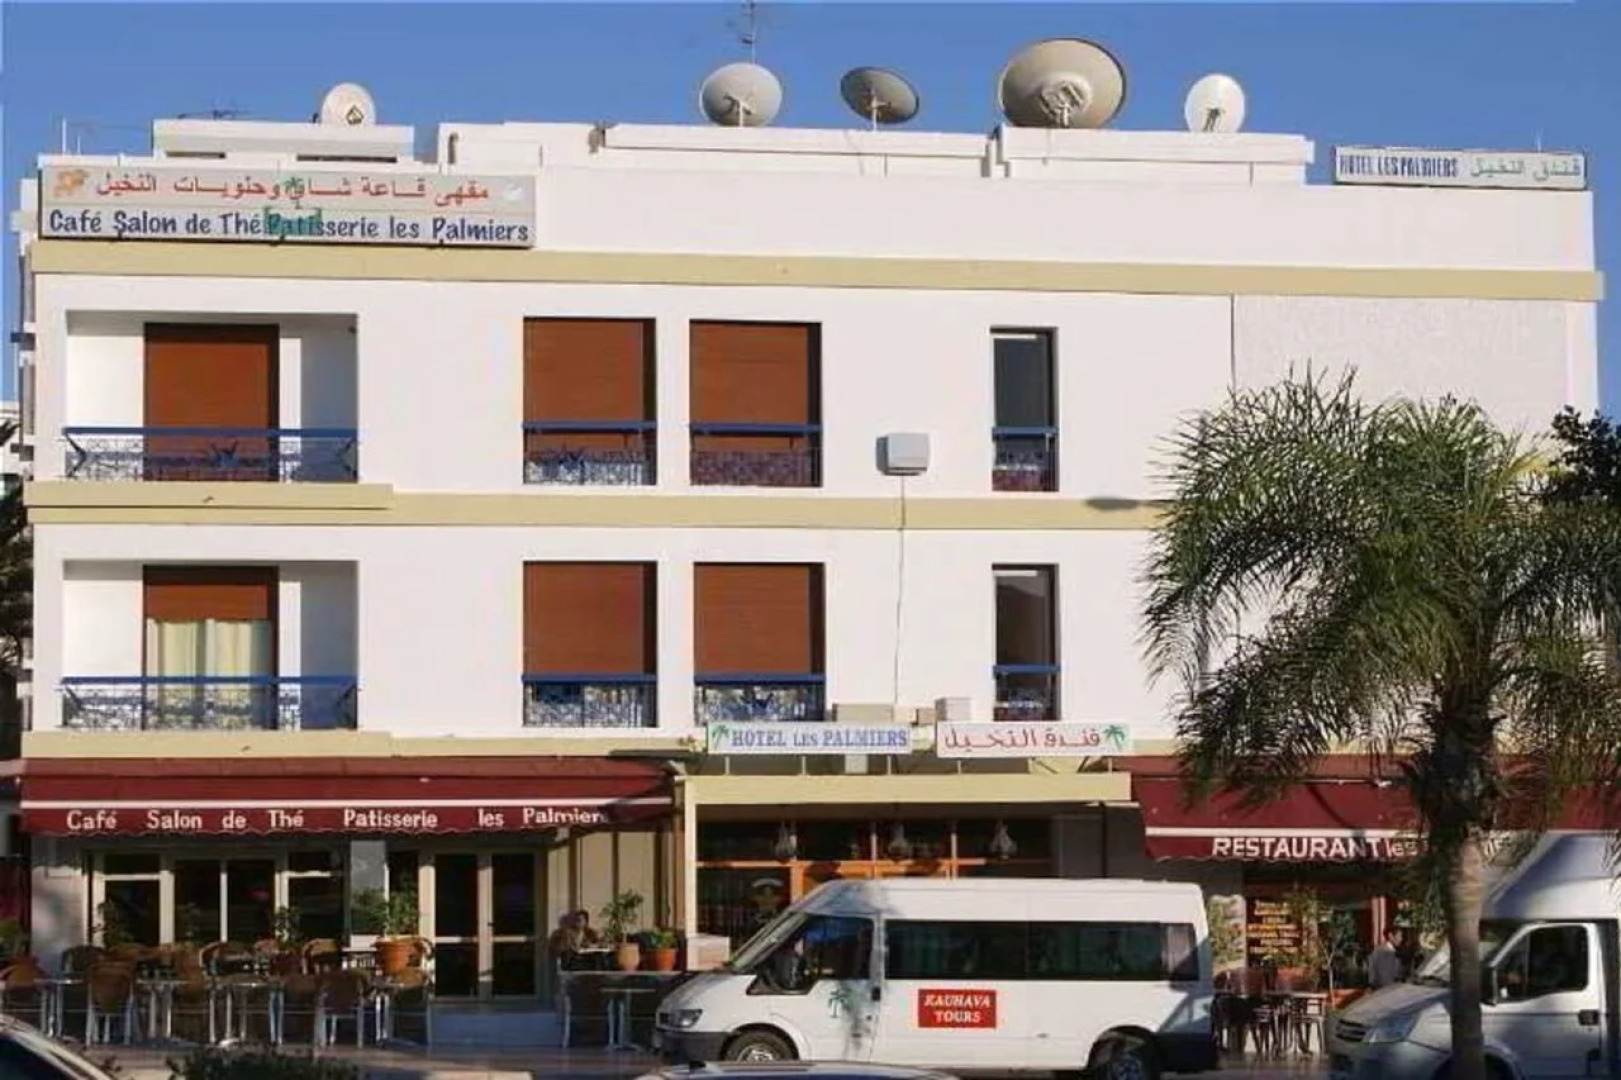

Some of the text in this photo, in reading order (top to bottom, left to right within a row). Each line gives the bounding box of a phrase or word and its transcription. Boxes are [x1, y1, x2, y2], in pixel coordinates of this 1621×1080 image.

[1340, 155, 1458, 178] HOTEL LES PALMIERS
[1533, 157, 1580, 181] فندق
[96, 172, 157, 196] النخيل
[359, 176, 427, 197] قاعة
[50, 209, 528, 241] Café Salon de Thé Patisserie les Palmiers
[732, 730, 786, 747] HOTEL
[823, 730, 908, 747] PALMIERS
[66, 810, 117, 829] Café
[147, 810, 202, 829] Salon
[222, 810, 247, 829] de
[268, 809, 304, 828] Thé
[343, 809, 438, 828] Patisserie
[478, 809, 504, 827] les
[1212, 837, 1418, 858] RESTAURANT les
[934, 1010, 981, 1023] TOURS
